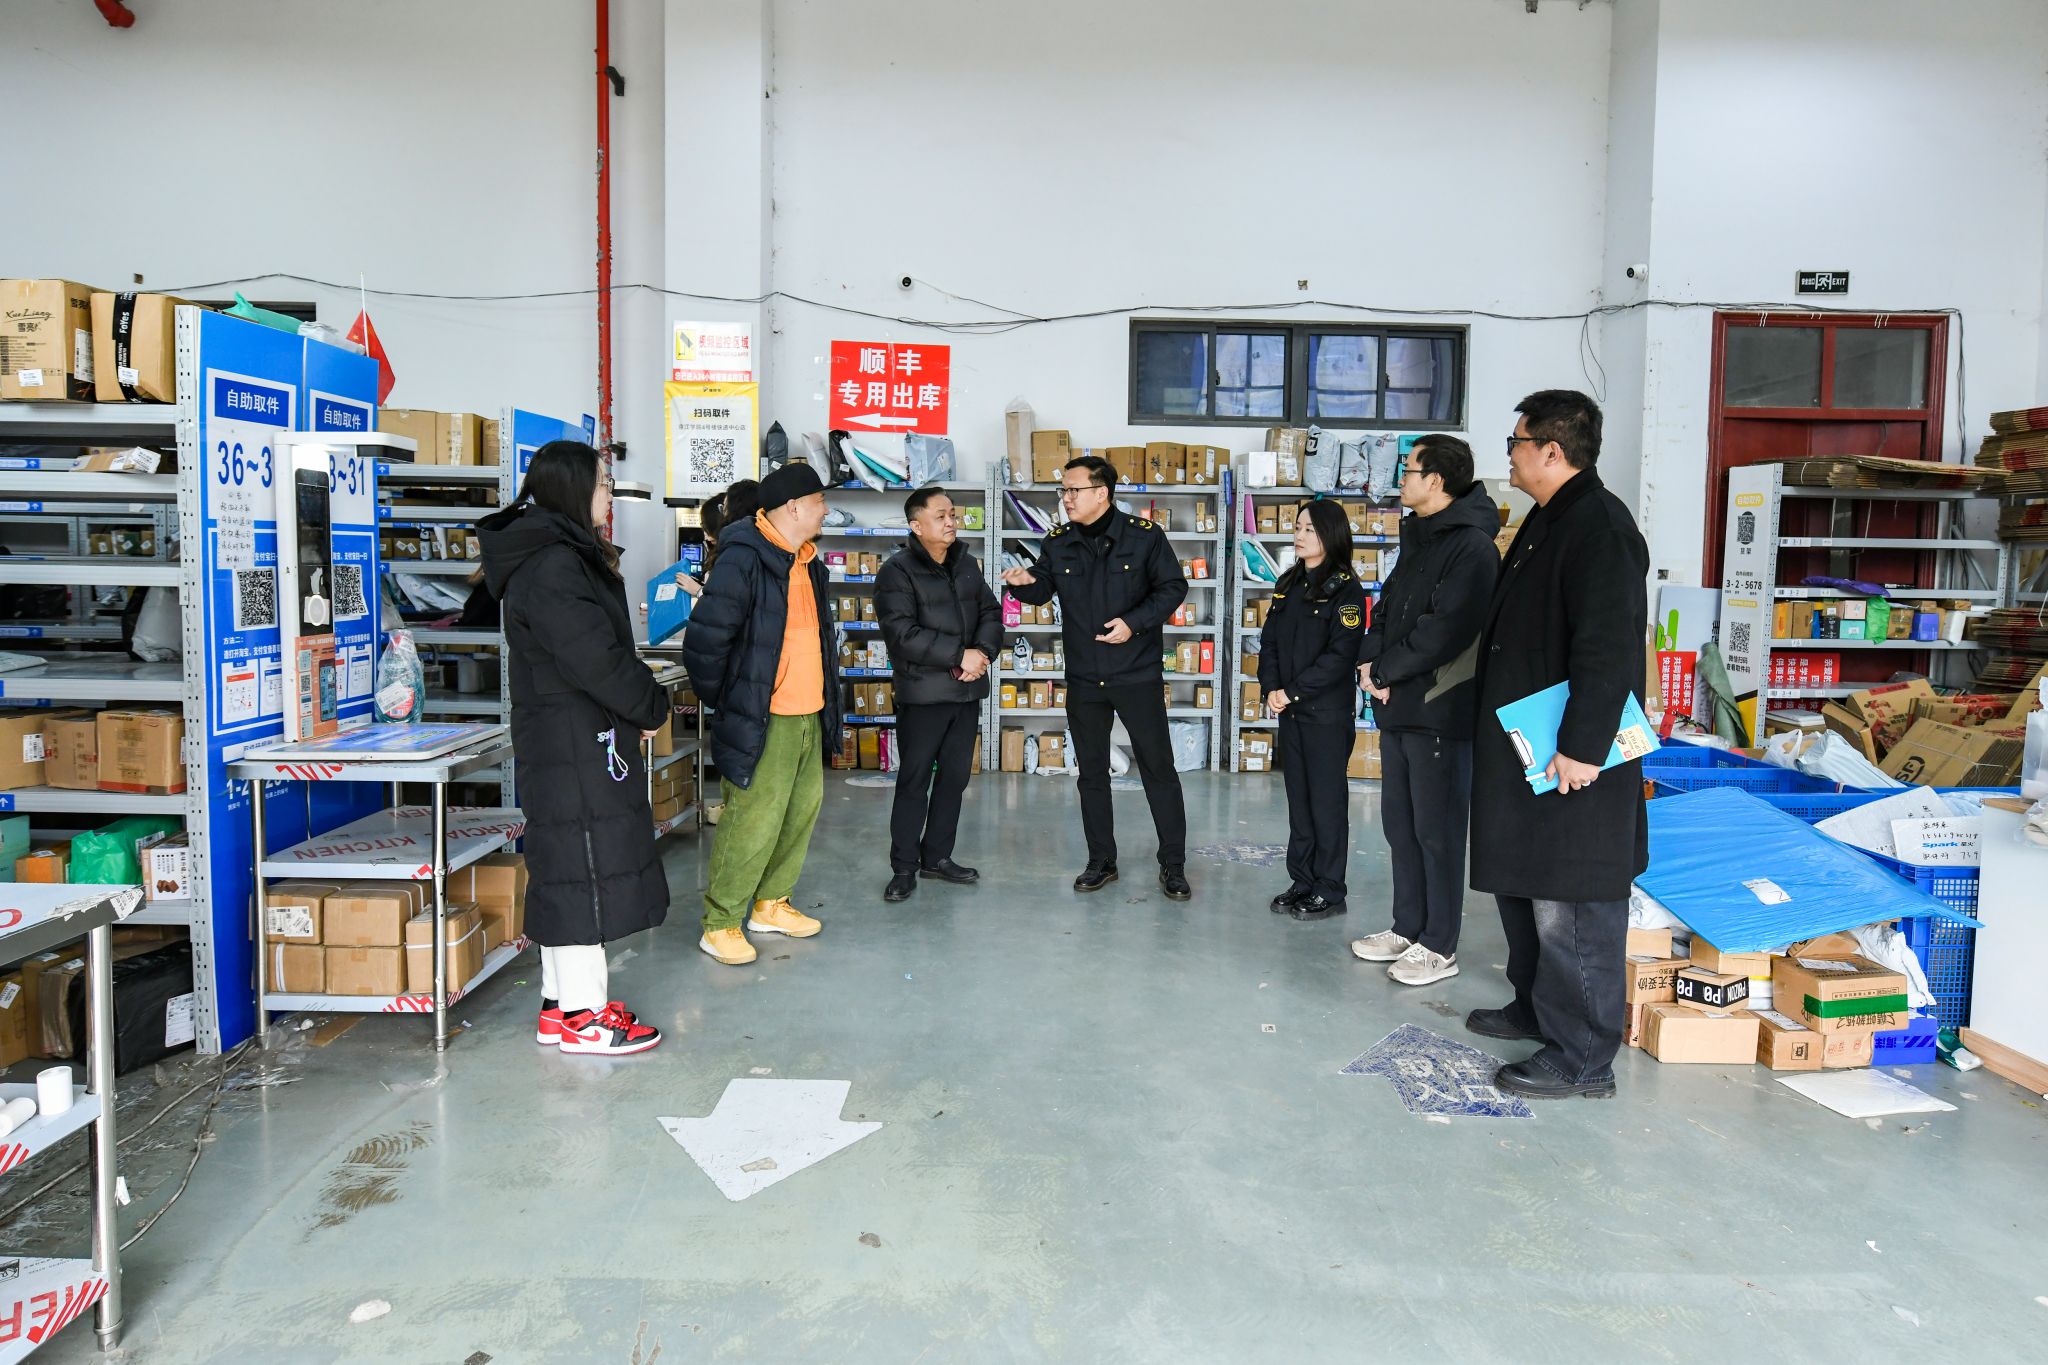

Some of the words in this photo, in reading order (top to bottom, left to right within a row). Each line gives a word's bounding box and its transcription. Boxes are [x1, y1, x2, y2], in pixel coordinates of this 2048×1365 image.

[1832, 277, 1847, 285] EXIT
[119, 311, 130, 334] FoYes
[858, 347, 923, 376] 顺丰
[227, 388, 280, 415] 自助取件
[838, 379, 941, 411] 专用出库
[323, 404, 362, 431] 自助取件
[693, 408, 731, 418] 扫码取件
[217, 440, 273, 488] 36~3
[292, 835, 418, 861] KITCHEN
[1637, 975, 1679, 991] 全无妥协
